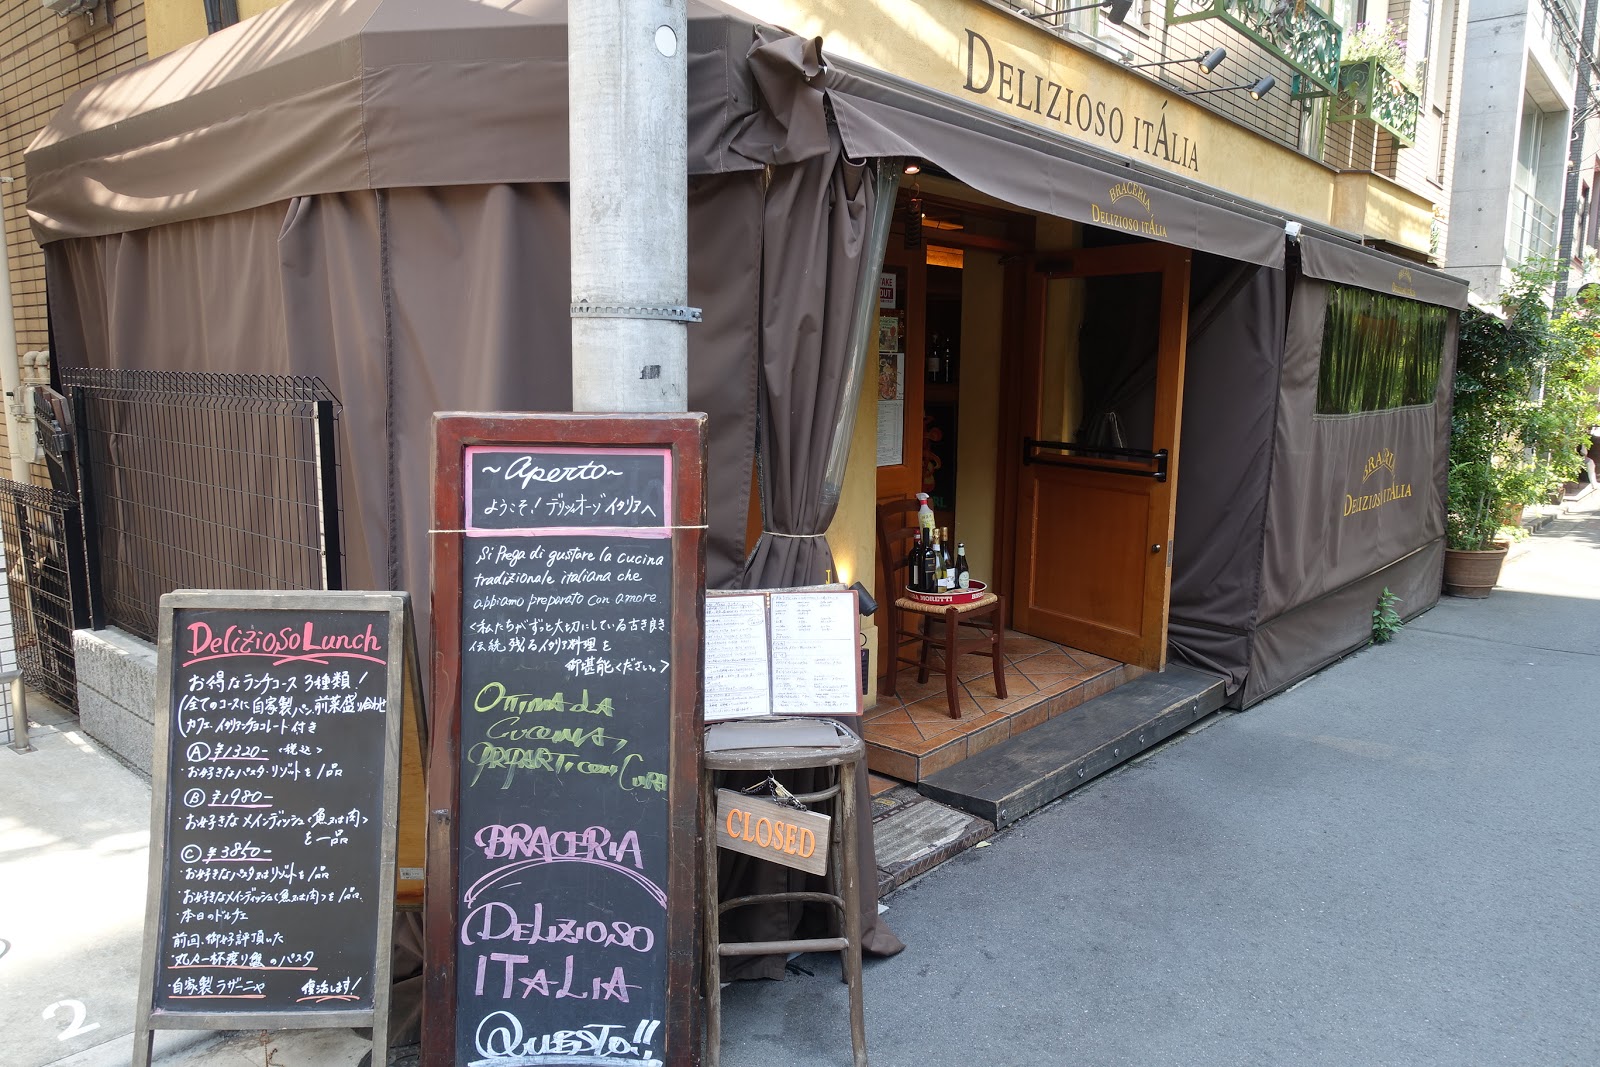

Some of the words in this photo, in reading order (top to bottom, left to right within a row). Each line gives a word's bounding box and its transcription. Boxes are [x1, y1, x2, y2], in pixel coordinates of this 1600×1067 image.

[1109, 182, 1151, 211] BRACERIA
[529, 545, 545, 560] di
[546, 547, 596, 567] gustare
[599, 546, 612, 562] la
[473, 569, 555, 588] tradizionale
[560, 568, 612, 584] italiana
[617, 569, 643, 582] che
[726, 808, 815, 858] CLOSED
